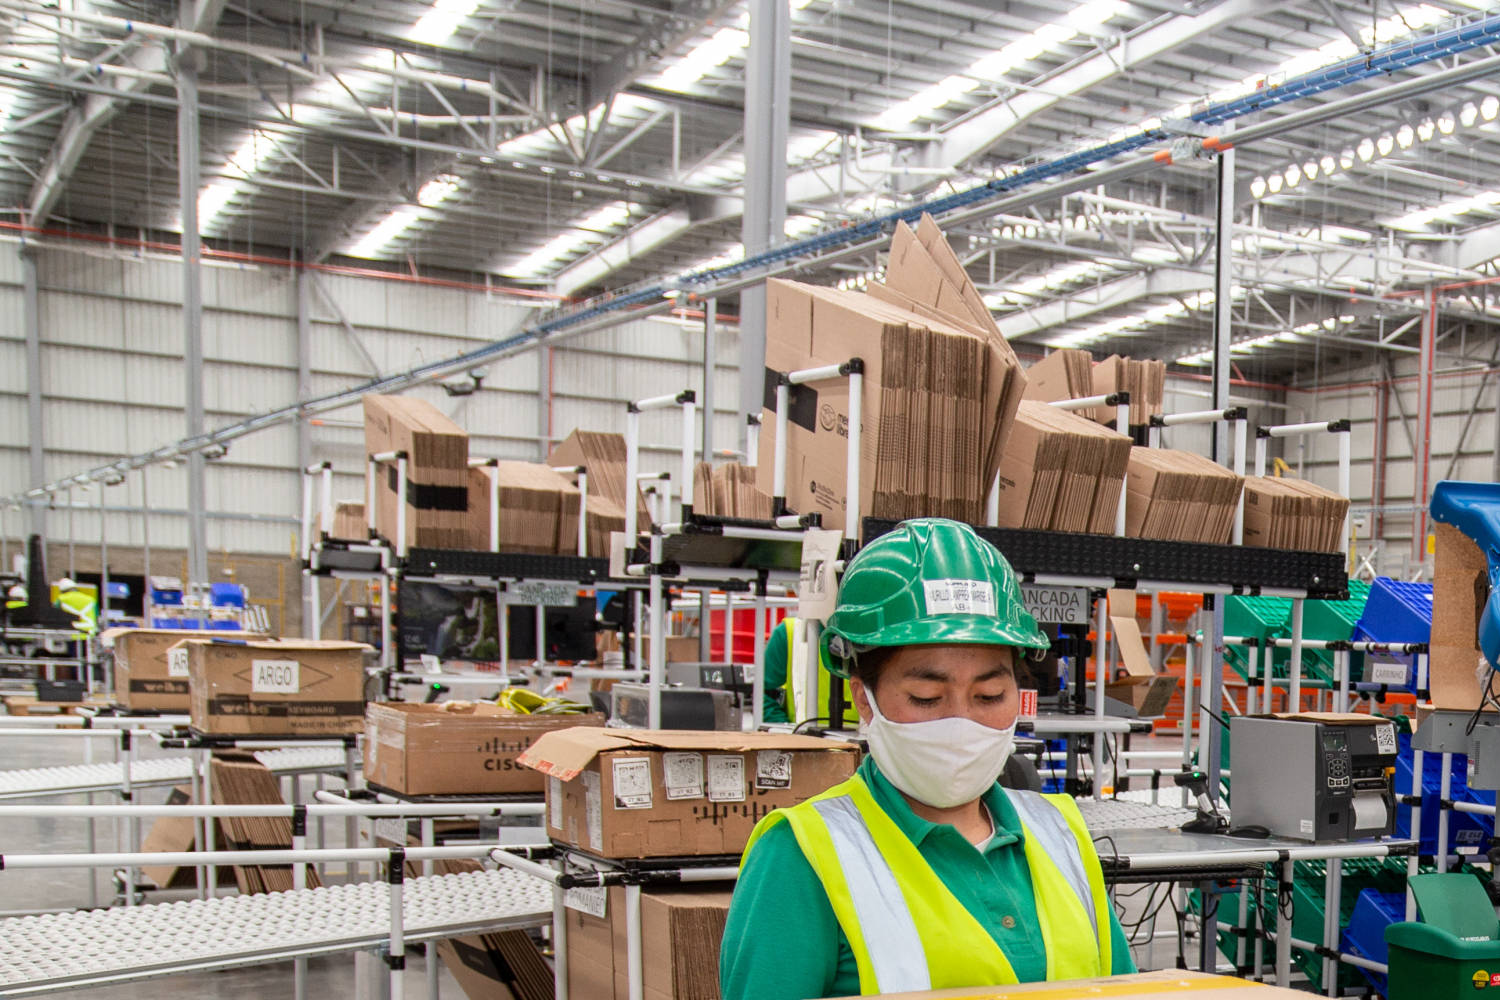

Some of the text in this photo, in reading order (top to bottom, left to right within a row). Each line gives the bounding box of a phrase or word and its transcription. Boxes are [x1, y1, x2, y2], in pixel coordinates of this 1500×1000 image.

[1025, 606, 1076, 622] CKING
[257, 664, 293, 687] ARGO
[484, 758, 534, 772] CISC
